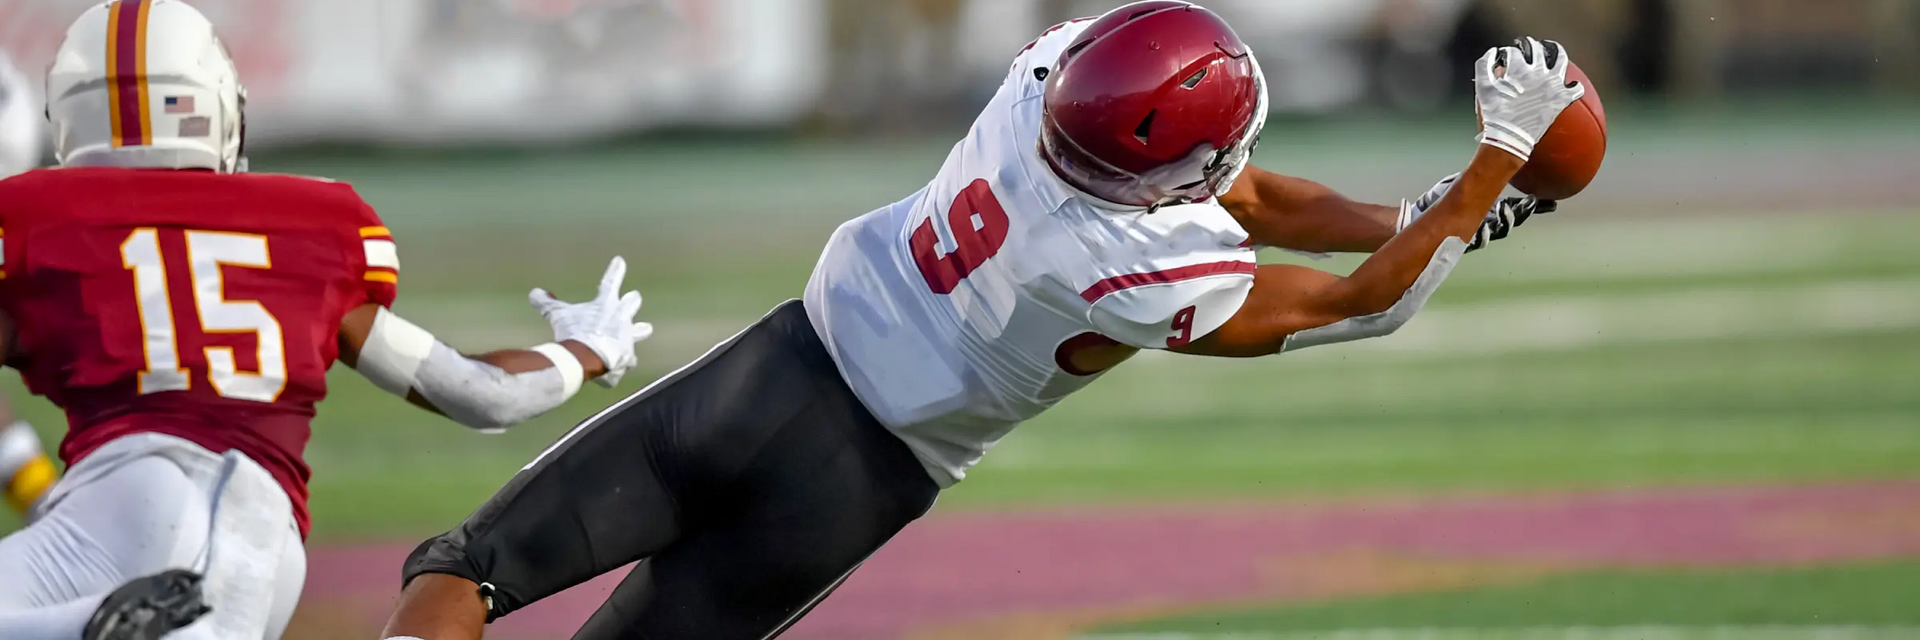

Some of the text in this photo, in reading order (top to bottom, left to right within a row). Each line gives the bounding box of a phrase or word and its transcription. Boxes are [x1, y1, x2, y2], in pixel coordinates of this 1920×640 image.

[910, 178, 1009, 295] 9
[120, 227, 287, 402] 15
[1166, 305, 1196, 348] 9
